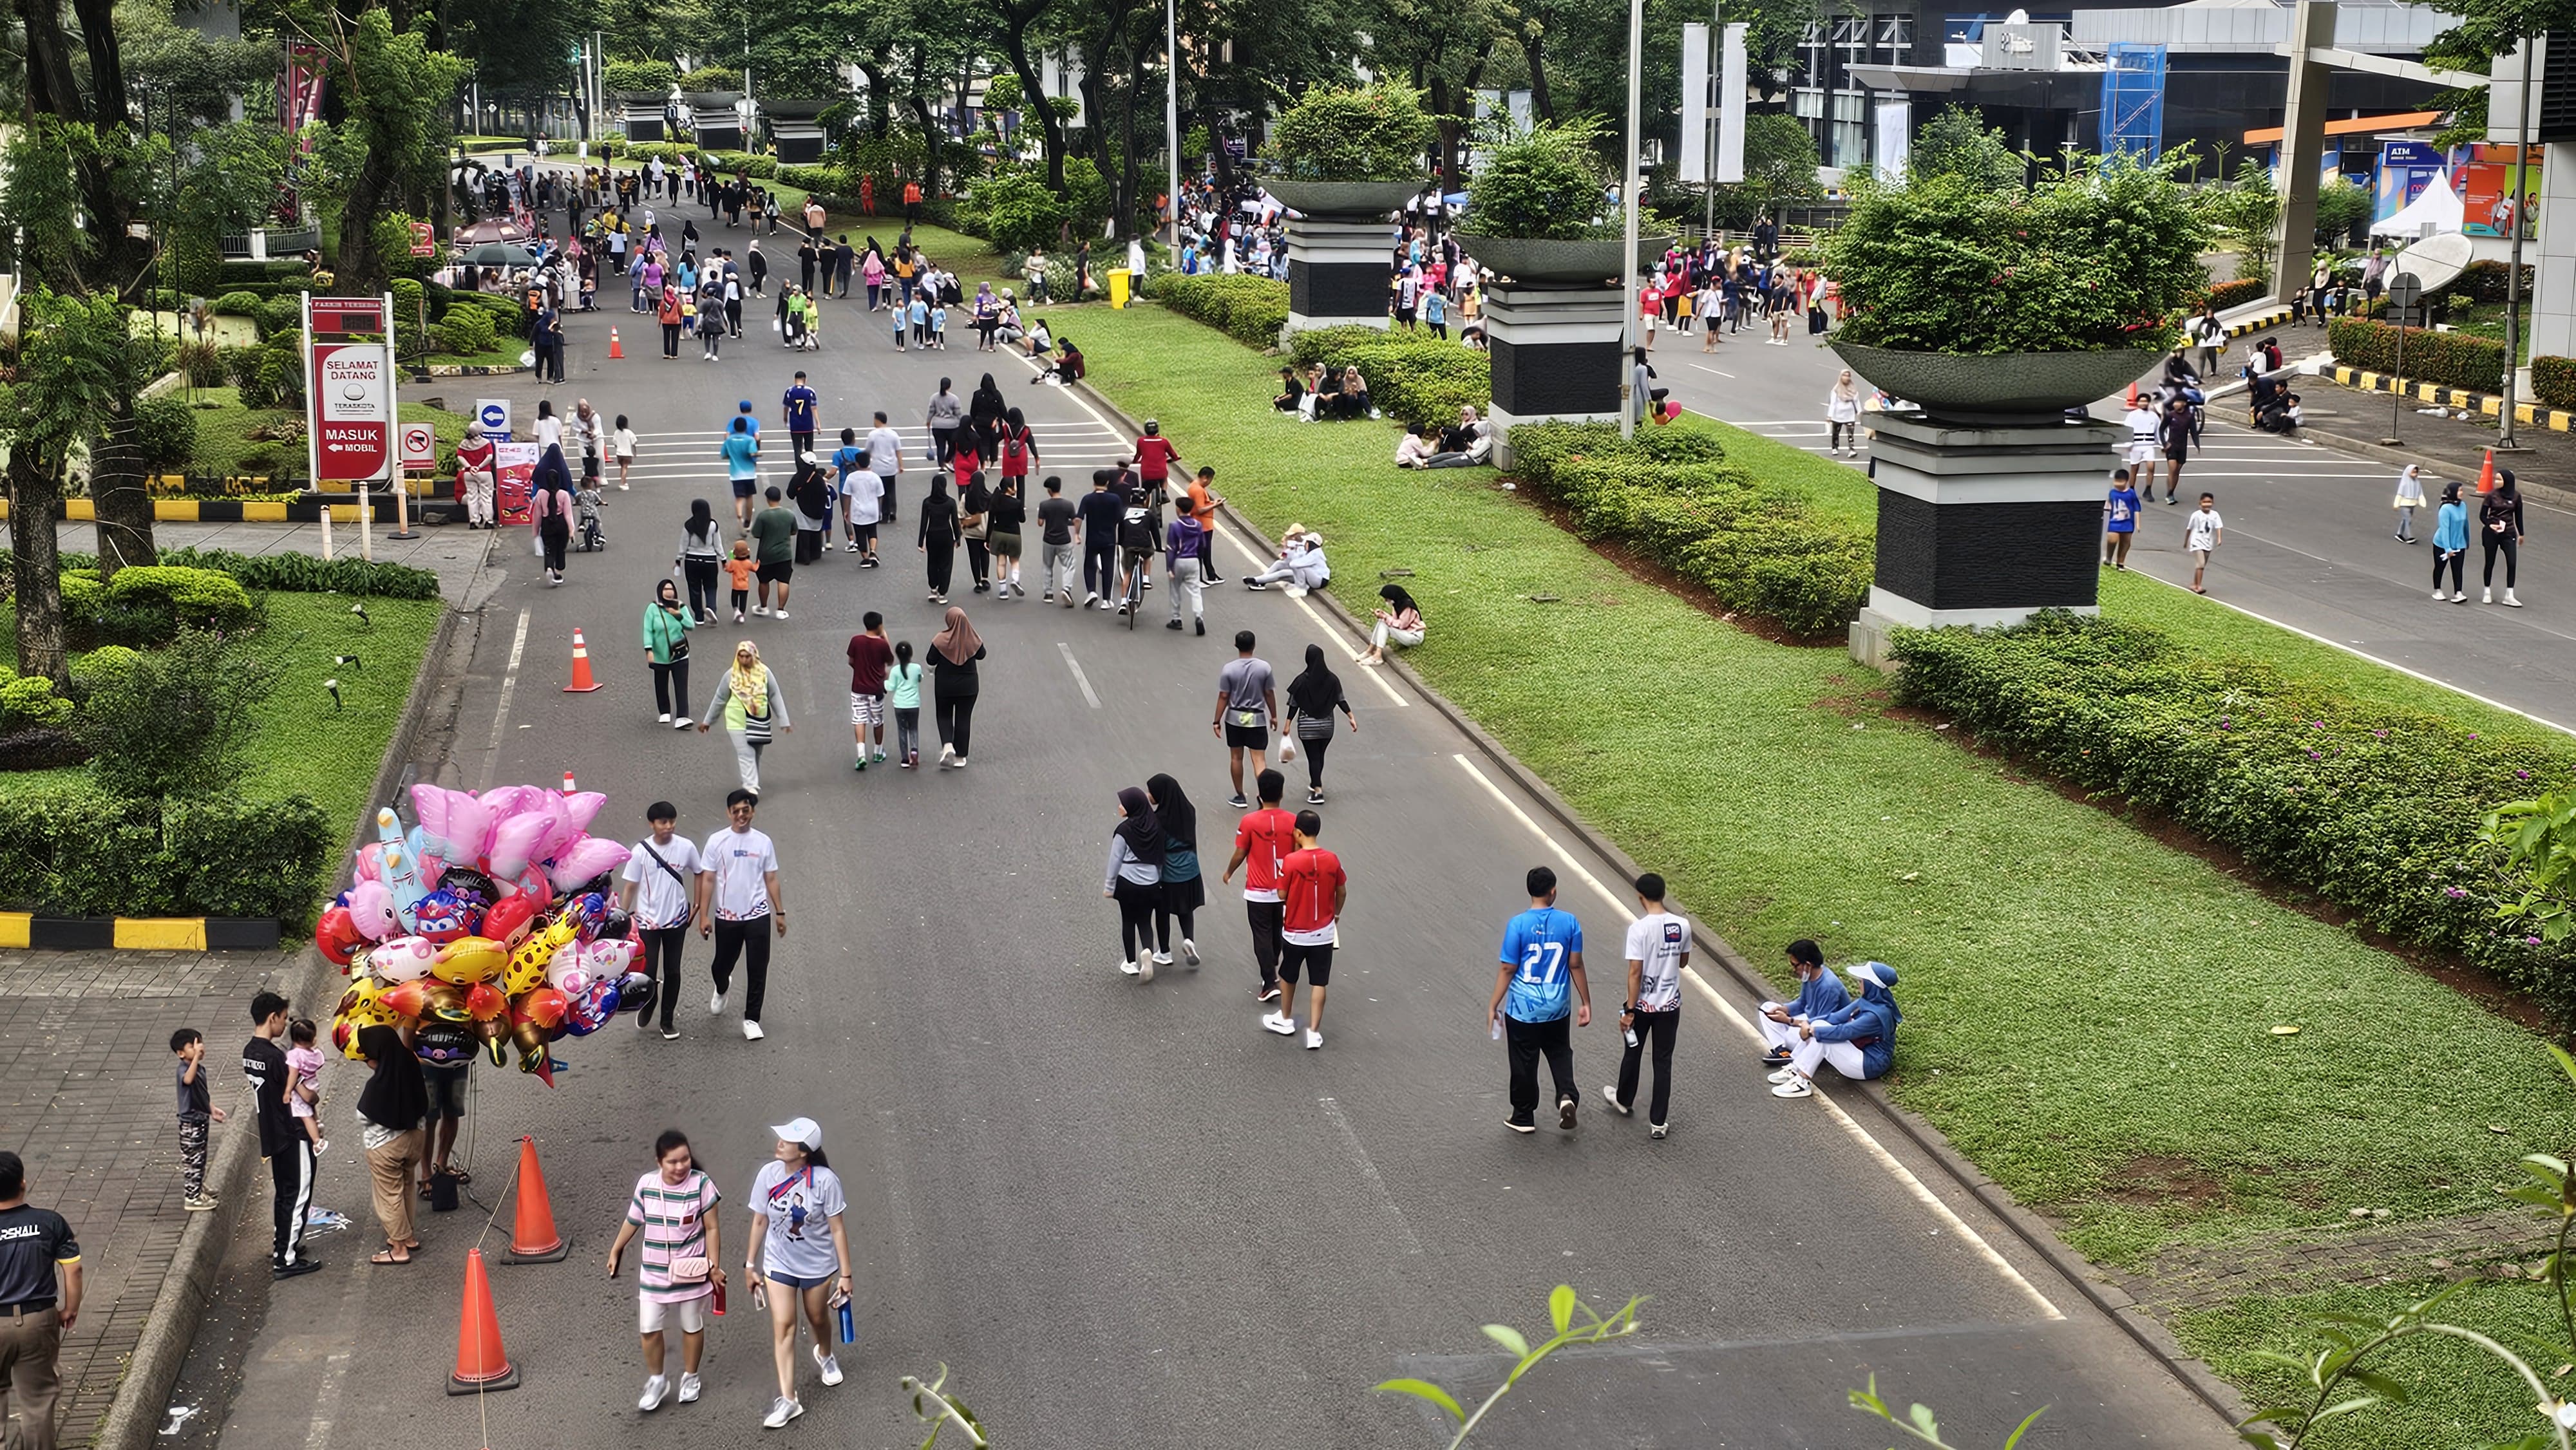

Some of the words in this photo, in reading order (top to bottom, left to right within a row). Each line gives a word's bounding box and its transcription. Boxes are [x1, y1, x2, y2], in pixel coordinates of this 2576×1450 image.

[327, 361, 378, 370] SELAMAT
[331, 372, 376, 380] DATANG
[795, 399, 804, 416] 7
[325, 429, 378, 440] MASUK
[345, 444, 378, 453] MOBIL
[1523, 942, 1564, 984] 27
